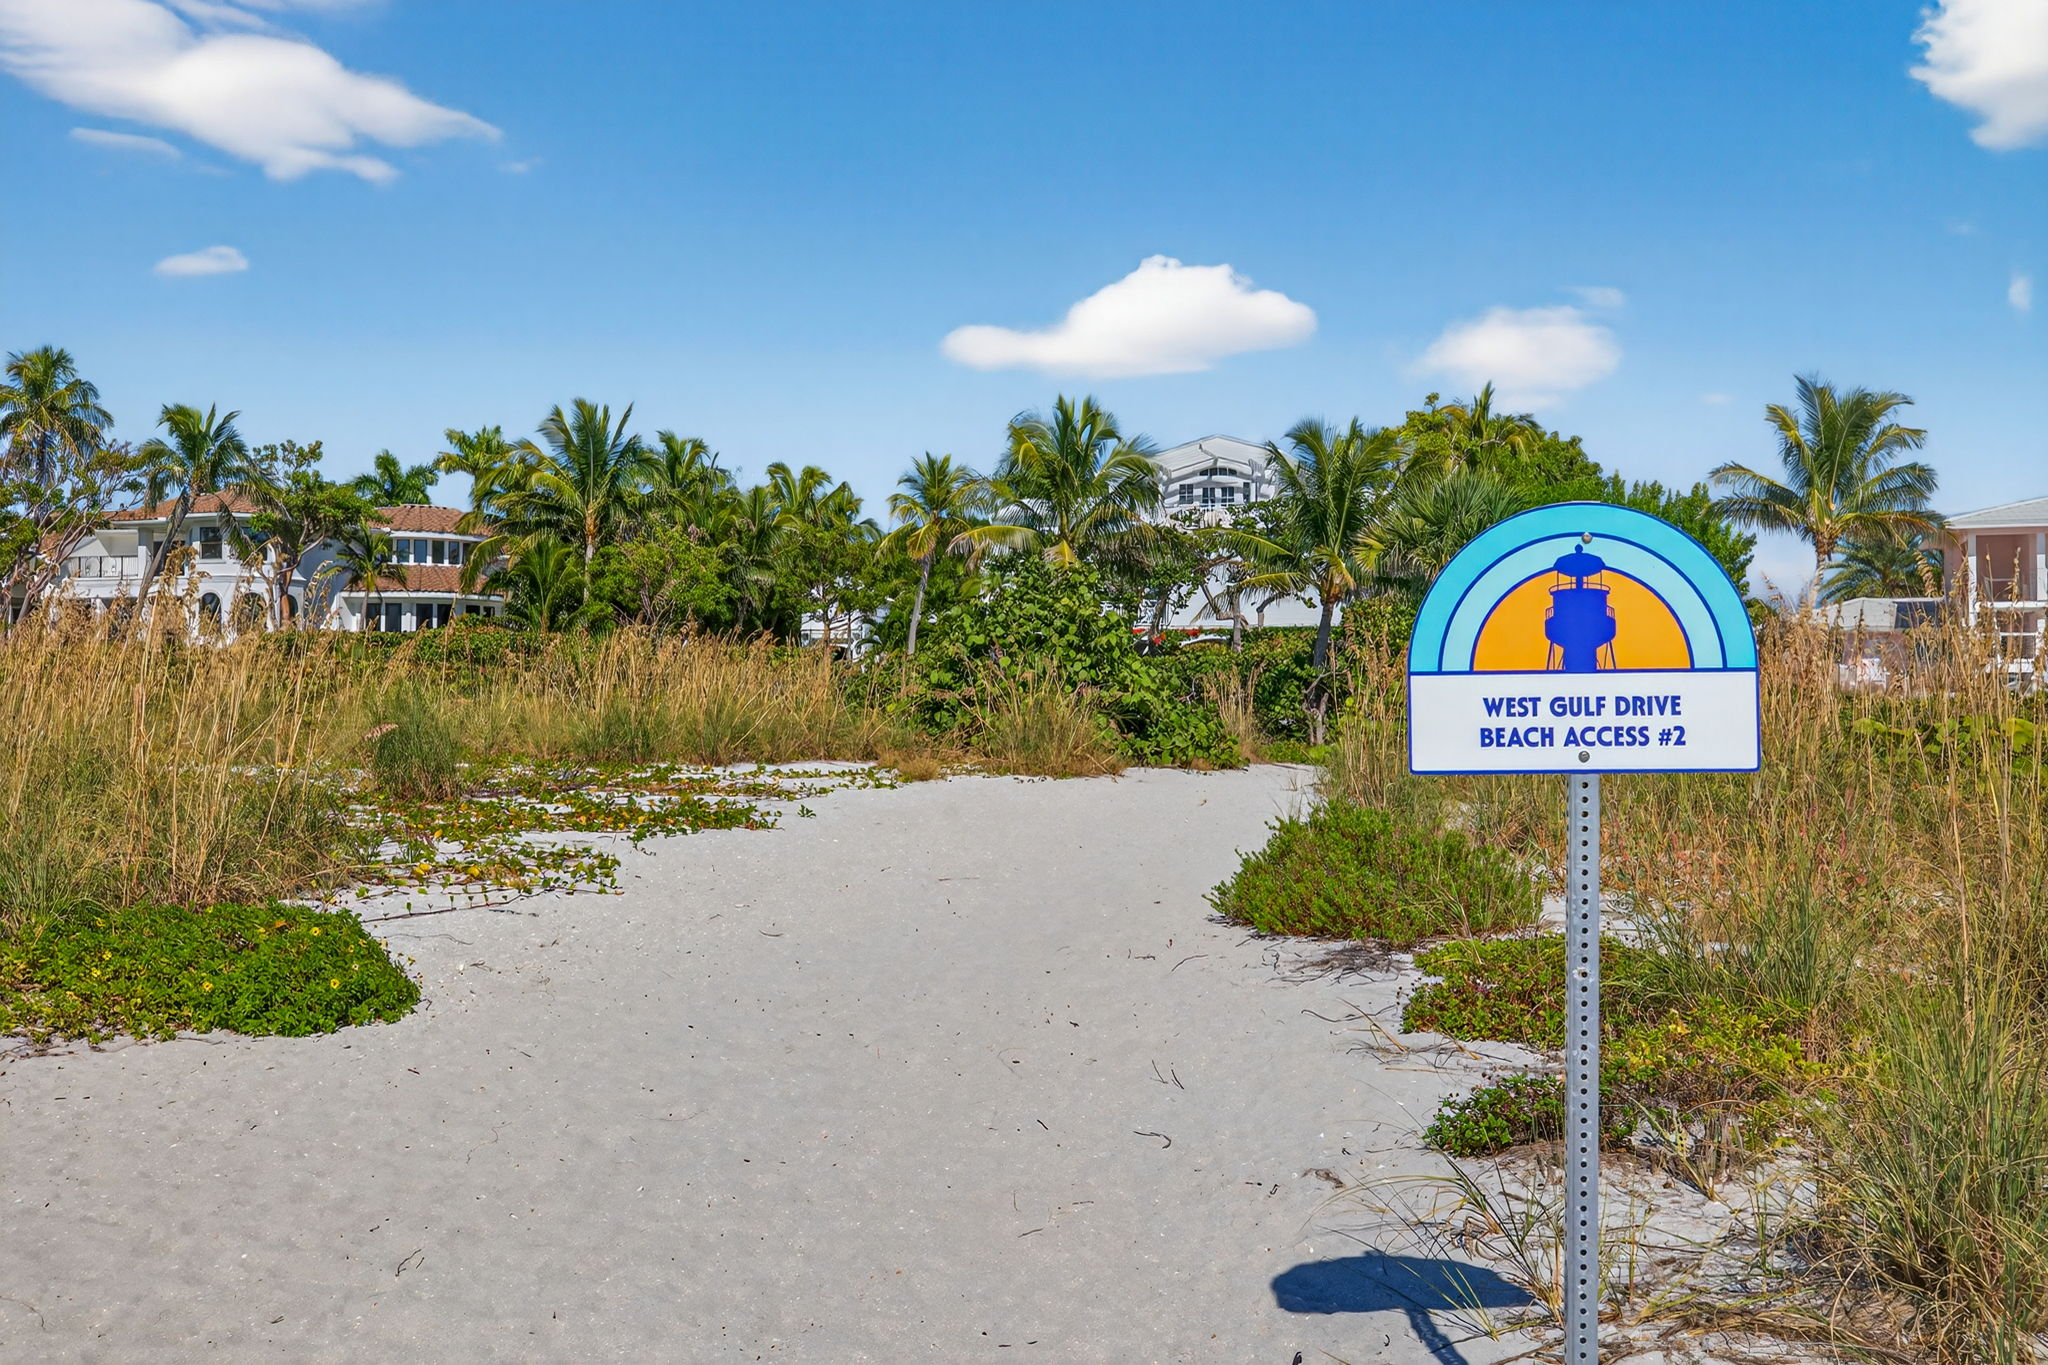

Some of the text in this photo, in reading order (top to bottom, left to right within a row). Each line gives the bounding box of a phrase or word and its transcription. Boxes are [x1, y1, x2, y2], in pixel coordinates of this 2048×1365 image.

[1482, 695, 1682, 717] WEST GULF DRIVE
[1480, 725, 1687, 747] BEACH ACCESS #2
